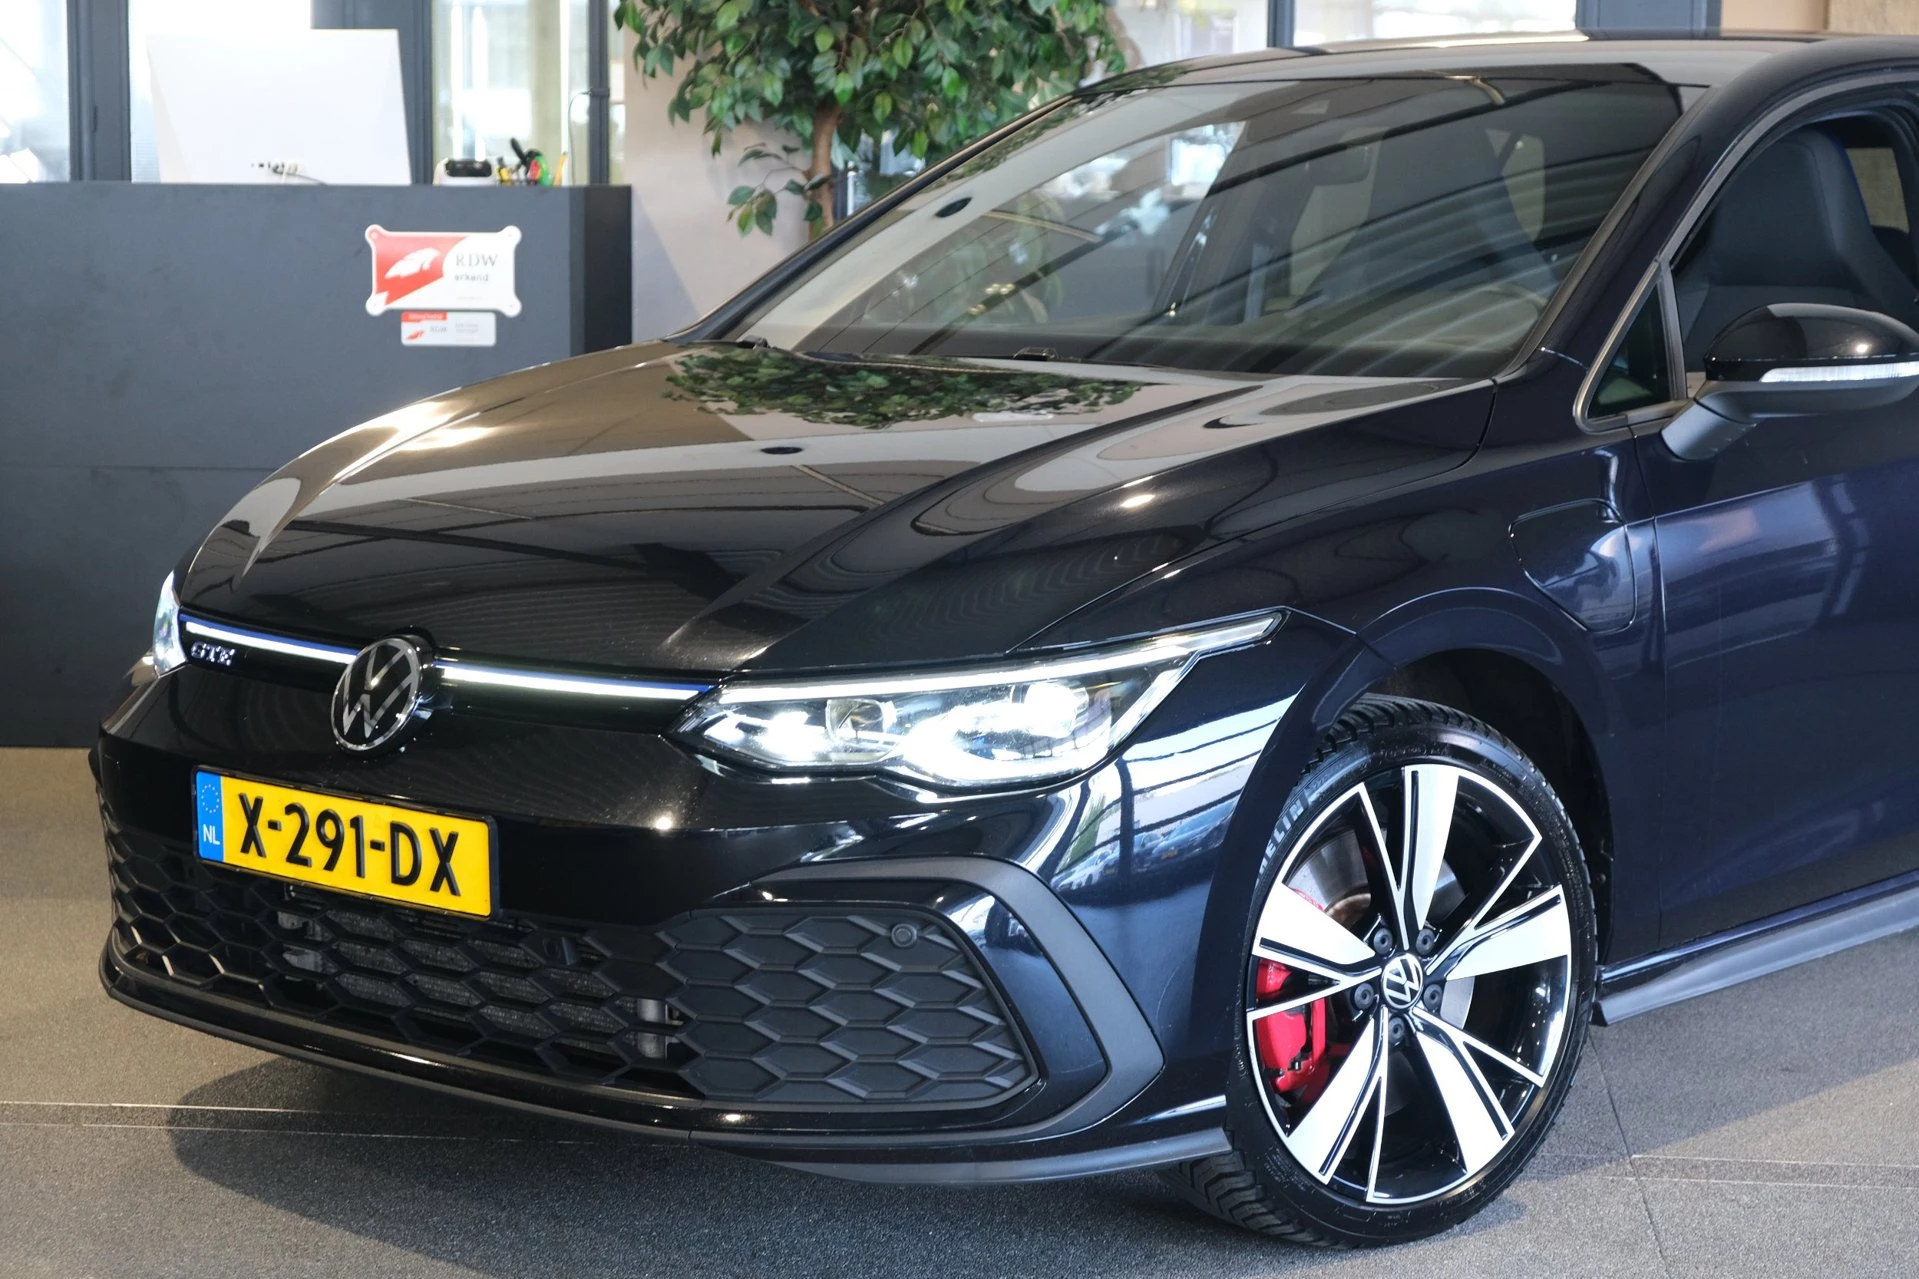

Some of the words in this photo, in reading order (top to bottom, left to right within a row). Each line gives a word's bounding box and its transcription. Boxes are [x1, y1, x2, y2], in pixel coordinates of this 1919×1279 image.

[455, 253, 499, 267] RDW
[203, 823, 221, 845] NL
[238, 792, 461, 897] X-291-DX
